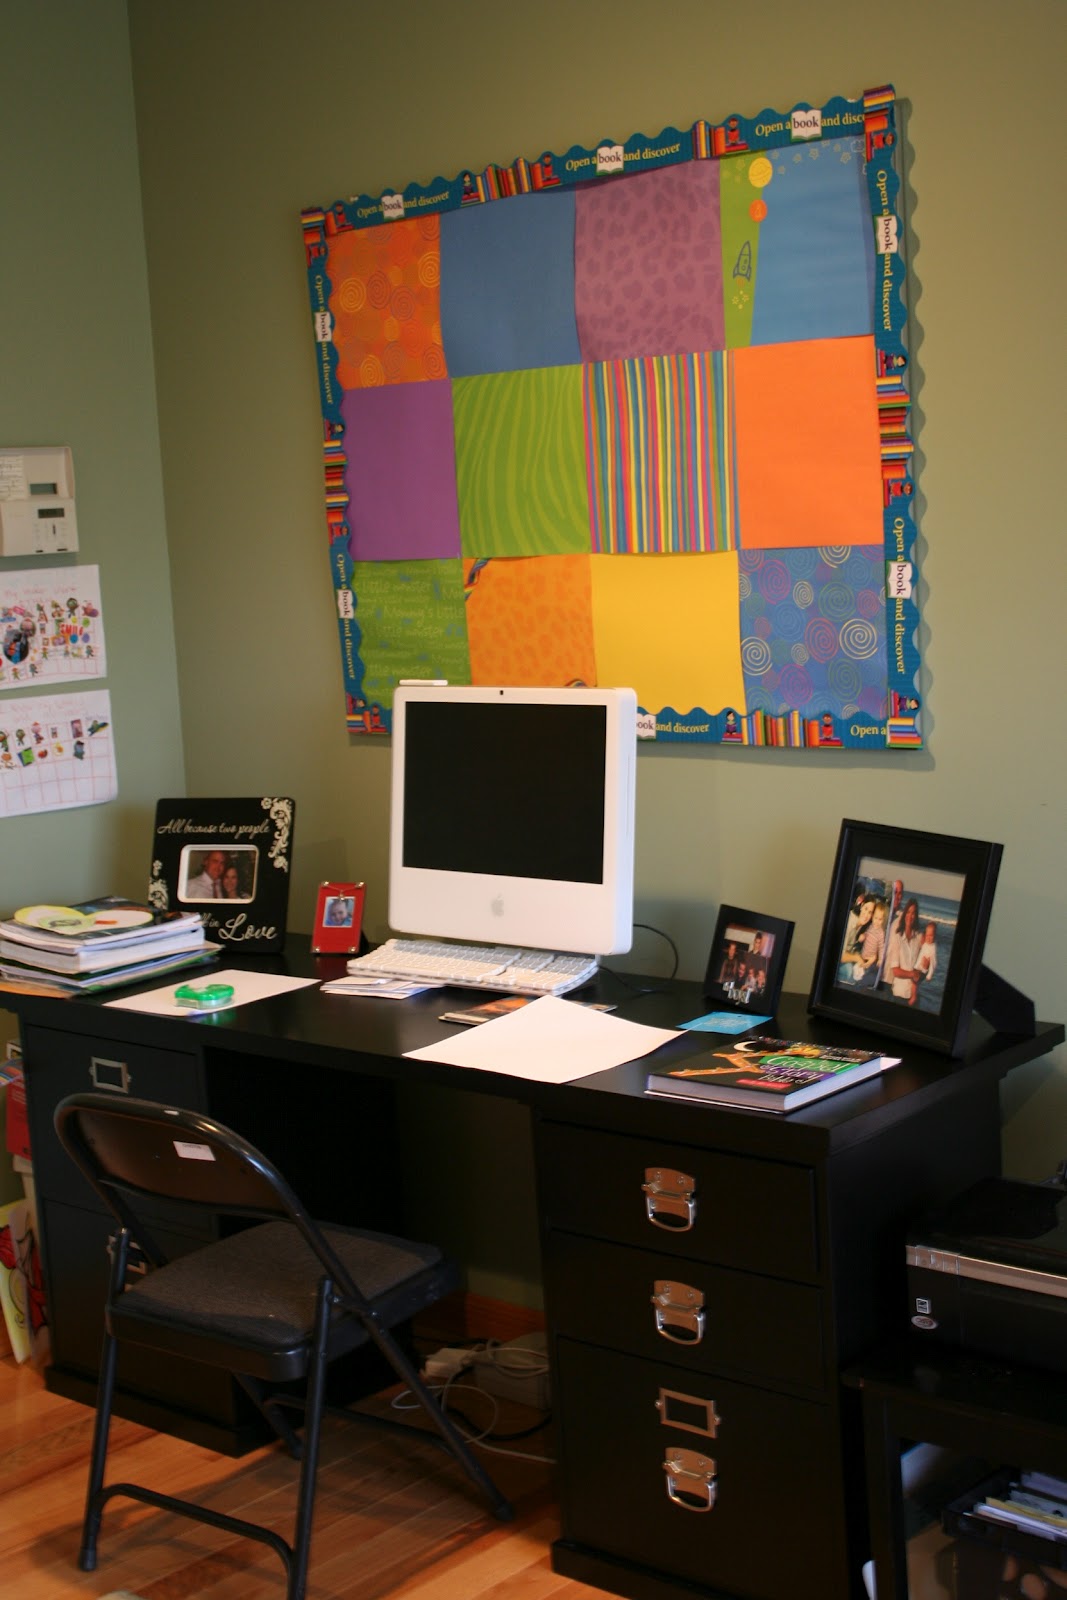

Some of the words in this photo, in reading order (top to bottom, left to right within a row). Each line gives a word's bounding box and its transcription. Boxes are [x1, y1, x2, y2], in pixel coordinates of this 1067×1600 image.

[755, 121, 783, 136] Open
[793, 116, 819, 129] book
[821, 114, 840, 127] and
[565, 157, 590, 171] Open
[591, 156, 597, 164] a
[598, 151, 622, 163] book
[623, 149, 640, 161] and
[642, 143, 680, 159] discover
[876, 169, 888, 206] Open
[357, 206, 378, 218] Open
[383, 199, 402, 211] book
[403, 198, 417, 208] and
[418, 191, 450, 206] discover
[883, 218, 892, 250] book
[884, 253, 893, 277] and
[314, 274, 324, 304] Open
[882, 279, 893, 331] discover
[319, 313, 329, 339] book
[321, 342, 330, 361] and
[322, 362, 333, 404] discover
[892, 517, 905, 553] Open
[336, 553, 347, 582] Open
[896, 564, 906, 595] book
[341, 590, 349, 617] book
[895, 598, 905, 621] and
[343, 618, 352, 637] and
[344, 638, 356, 679] discover
[894, 623, 905, 674] discover
[656, 722, 672, 732] and
[673, 722, 709, 734] discover
[850, 724, 879, 738] Open
[157, 818, 184, 834] All
[184, 818, 218, 834] because
[219, 822, 237, 834] two
[234, 818, 270, 839] people
[218, 912, 278, 941] Love
